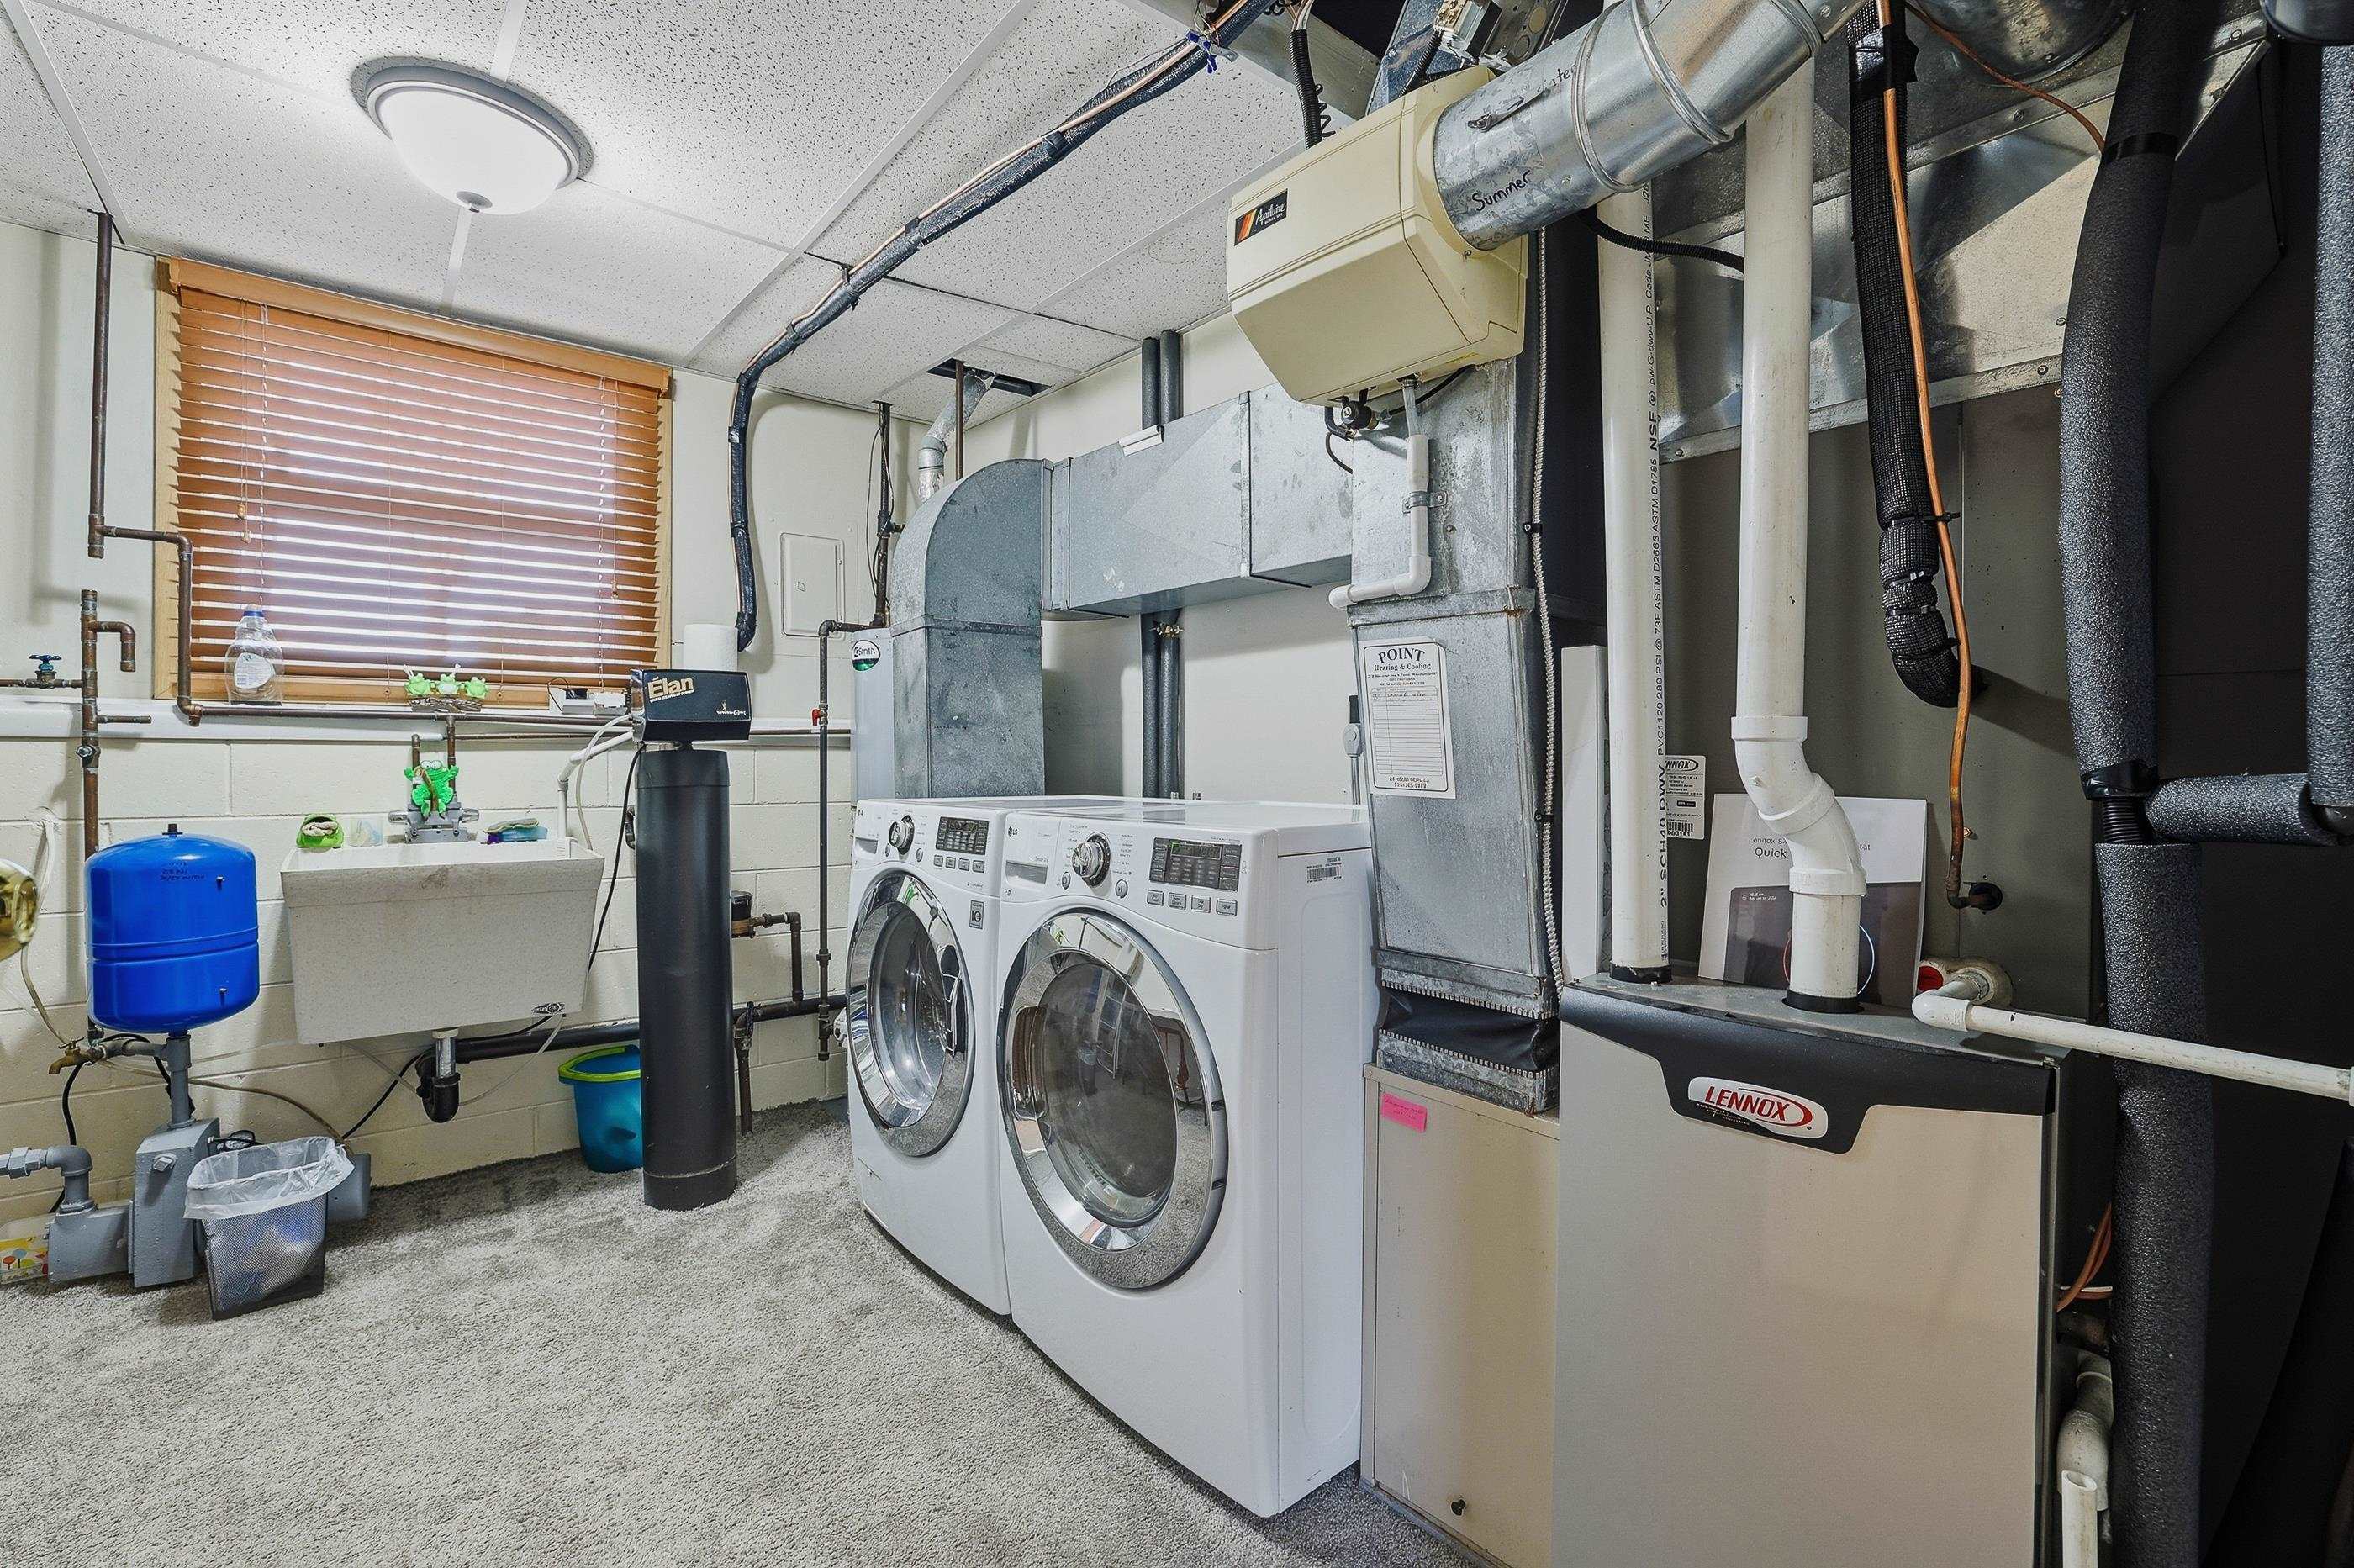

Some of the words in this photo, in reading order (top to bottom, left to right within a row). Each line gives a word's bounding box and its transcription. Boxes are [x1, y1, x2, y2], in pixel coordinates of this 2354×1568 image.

[1471, 169, 1531, 211] Summer
[1649, 410, 1658, 451] NSF
[1651, 498, 1660, 532] ASTM
[1653, 575, 1661, 610] ASTM
[1654, 613, 1662, 634] 73F
[1378, 647, 1425, 663] POINT
[647, 676, 694, 699] Élan
[1656, 702, 1665, 756] PVC1120
[1658, 764, 1666, 810] DWV
[1659, 817, 1667, 881] SCH40
[1755, 847, 1787, 858] Quick
[1704, 1085, 1790, 1122] LENNOX
